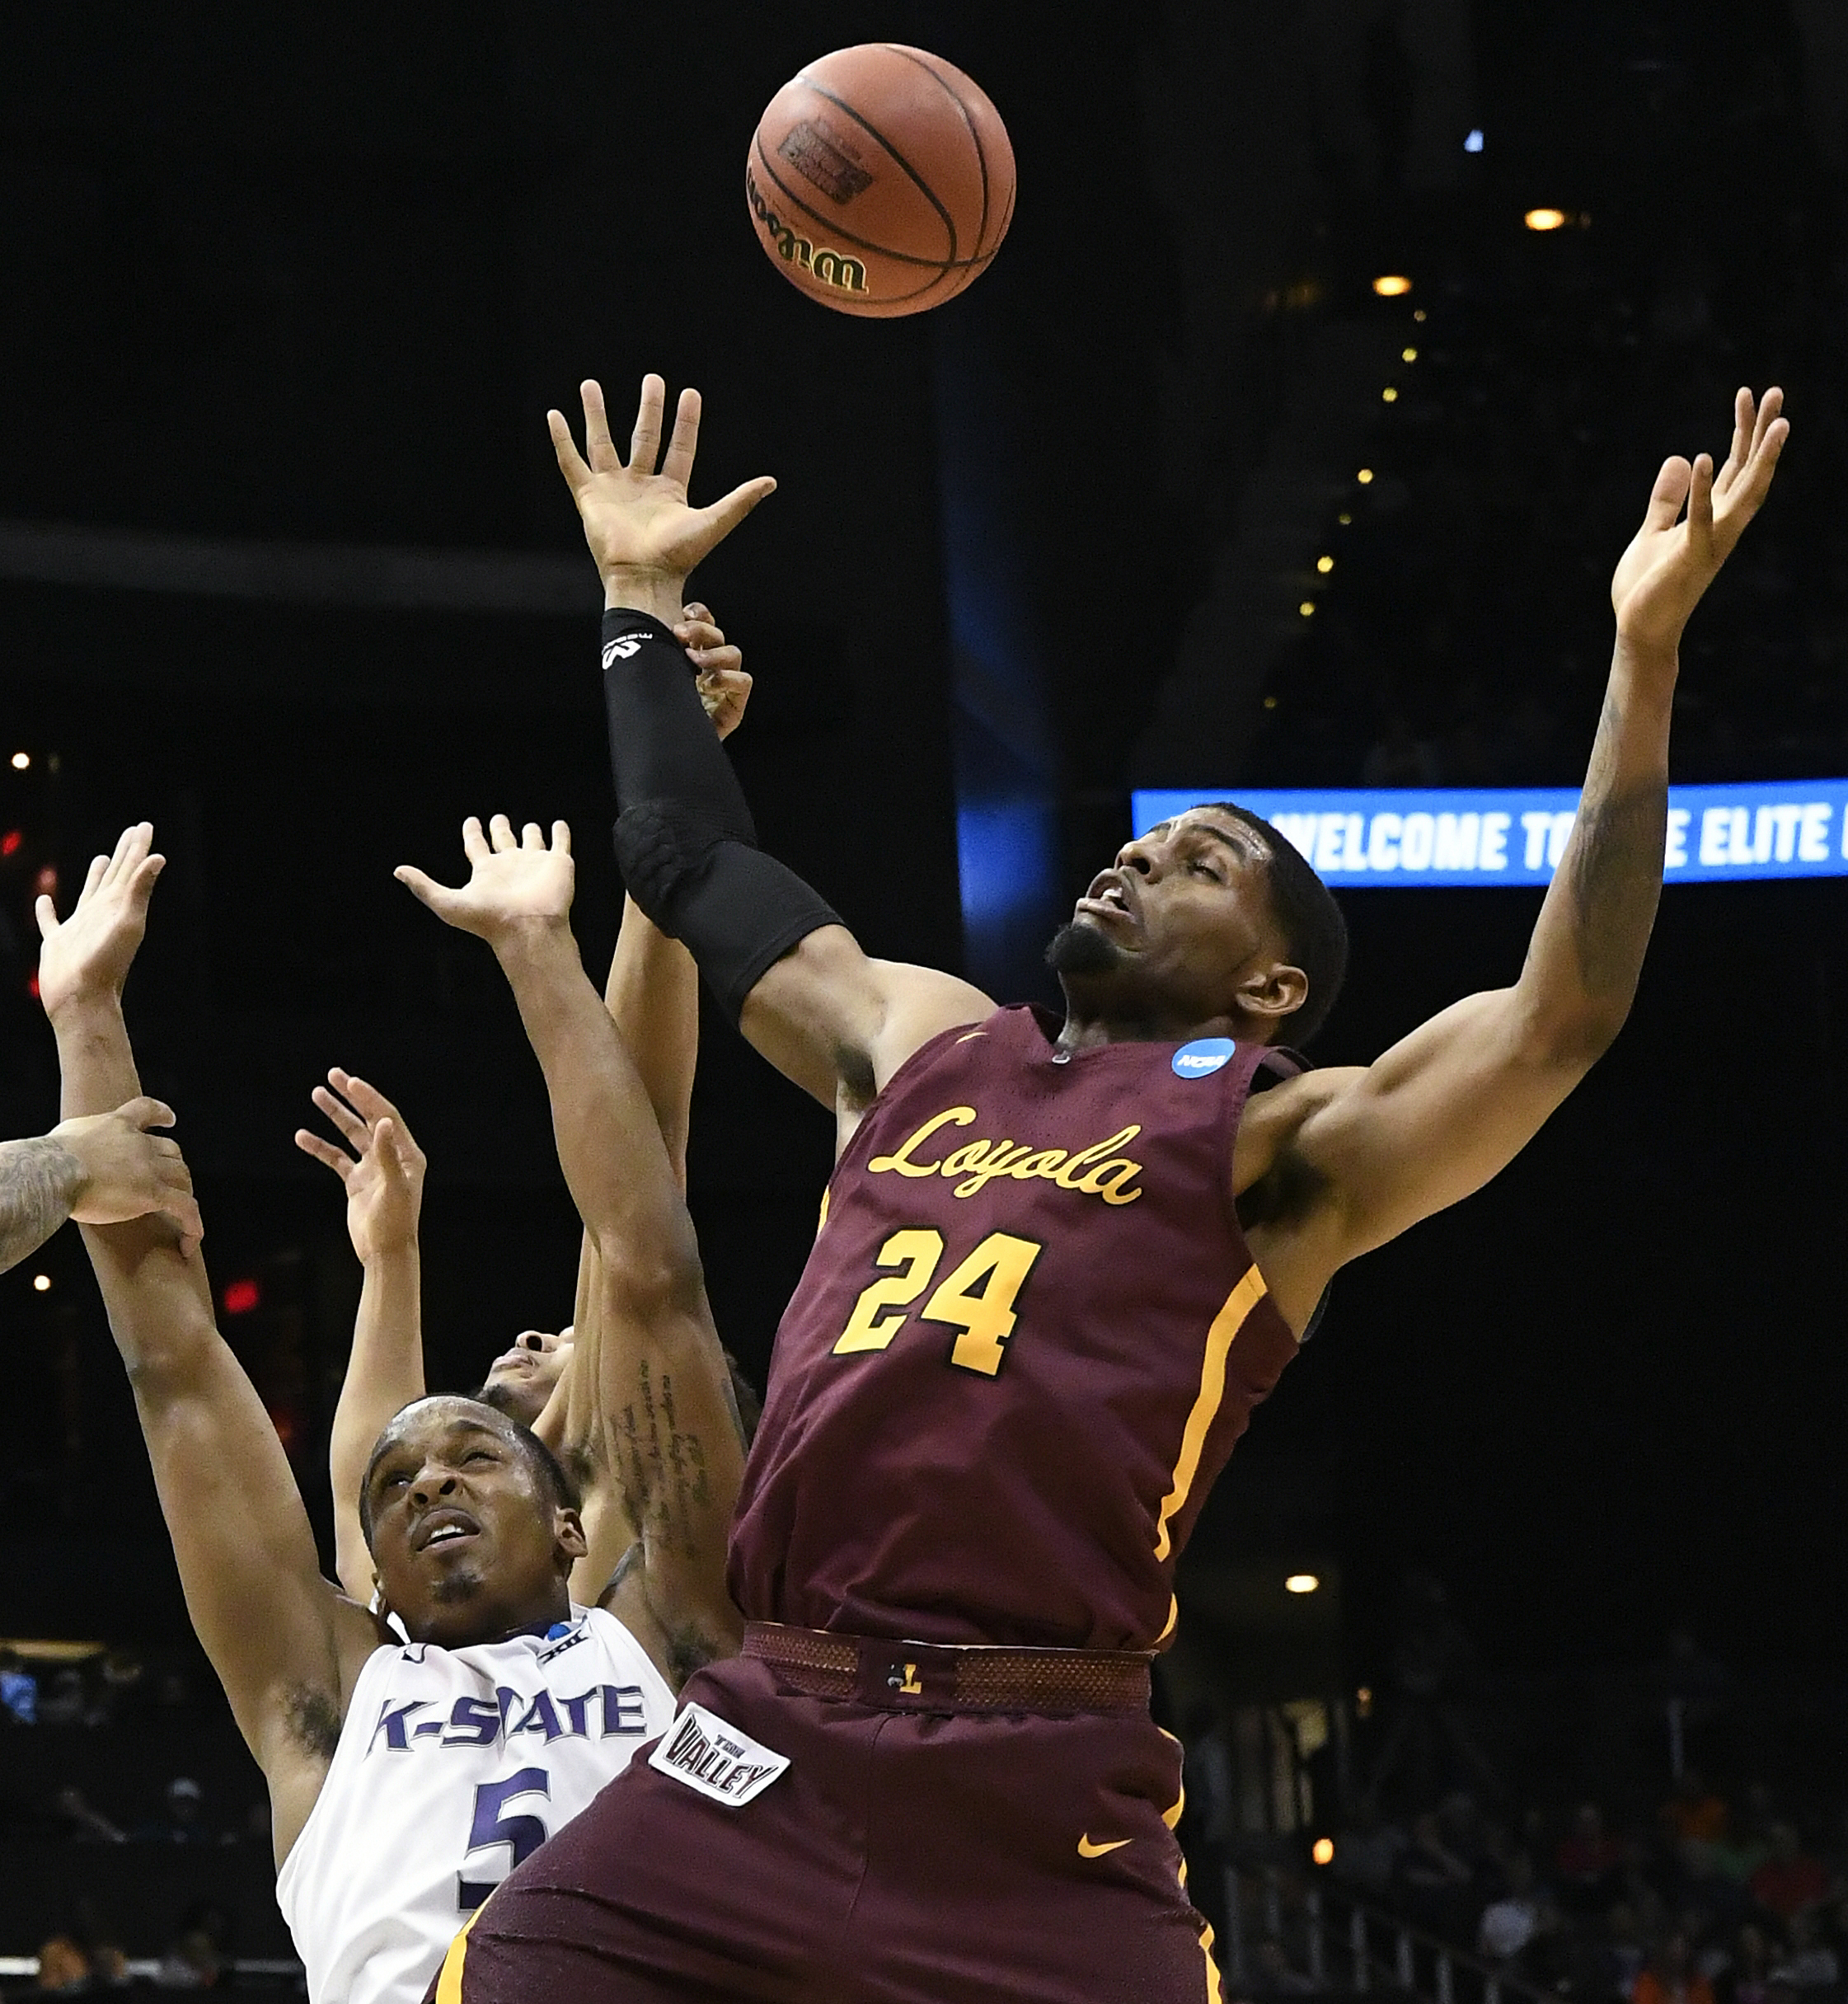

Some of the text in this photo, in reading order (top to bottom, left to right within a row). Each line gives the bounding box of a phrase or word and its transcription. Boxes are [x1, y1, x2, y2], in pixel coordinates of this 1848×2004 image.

[1699, 802, 1833, 866] ELITE
[867, 1105, 1144, 1206] Loyola
[831, 1226, 1046, 1380] 24
[663, 1713, 779, 1799] VALLEY
[457, 1767, 552, 1913] 5
